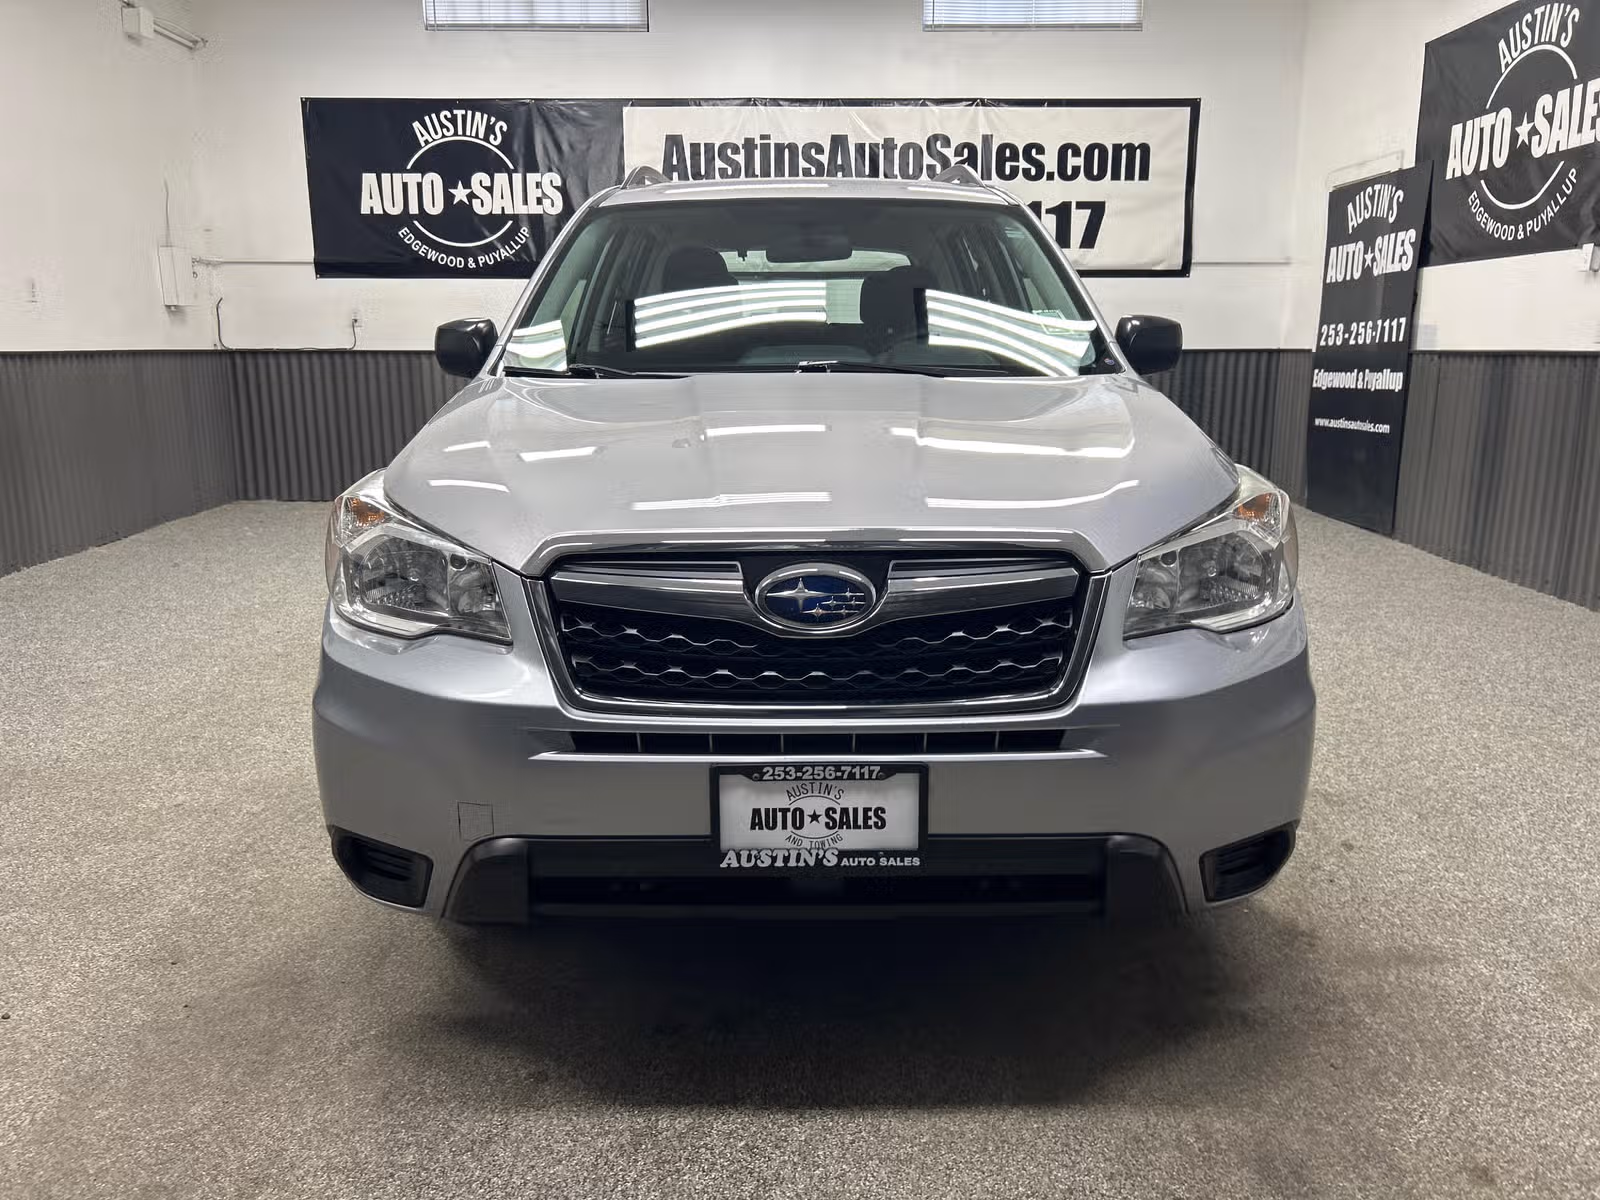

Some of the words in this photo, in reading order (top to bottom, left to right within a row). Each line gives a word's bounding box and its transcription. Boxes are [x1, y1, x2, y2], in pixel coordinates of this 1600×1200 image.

[1498, 3, 1580, 73] AUSTIN'S
[411, 109, 508, 148] AUSTIN'S
[1446, 107, 1512, 180] AUTO
[1531, 78, 1600, 158] SALE
[662, 133, 1151, 181] AustinsAutoSales.com
[360, 172, 444, 215] AUTO
[471, 172, 563, 215] SALES
[1348, 184, 1404, 234] AUSTIN'S
[1468, 190, 1515, 241] EDGEWOOD
[1517, 226, 1525, 240] &
[1526, 167, 1578, 237] PUYALLUP
[398, 226, 464, 269] EDGEWOOD
[467, 256, 476, 269] &
[478, 226, 532, 266] PUYALLUP
[1326, 240, 1365, 284] AUTO
[1373, 229, 1416, 277] SALES
[1319, 317, 1407, 346] 253-256-7117
[1312, 368, 1357, 391] Edgewood
[1357, 371, 1364, 390] &
[762, 766, 880, 780] 253-256-7117
[785, 781, 845, 802] AUSTIN'S
[750, 807, 805, 831] AUTO
[824, 806, 887, 830] SALES
[719, 848, 839, 868] AUSTIN'S
[840, 857, 876, 866] AUTO
[879, 857, 921, 866] SALES
[785, 834, 803, 847] AND
[809, 833, 844, 850] TOWING
